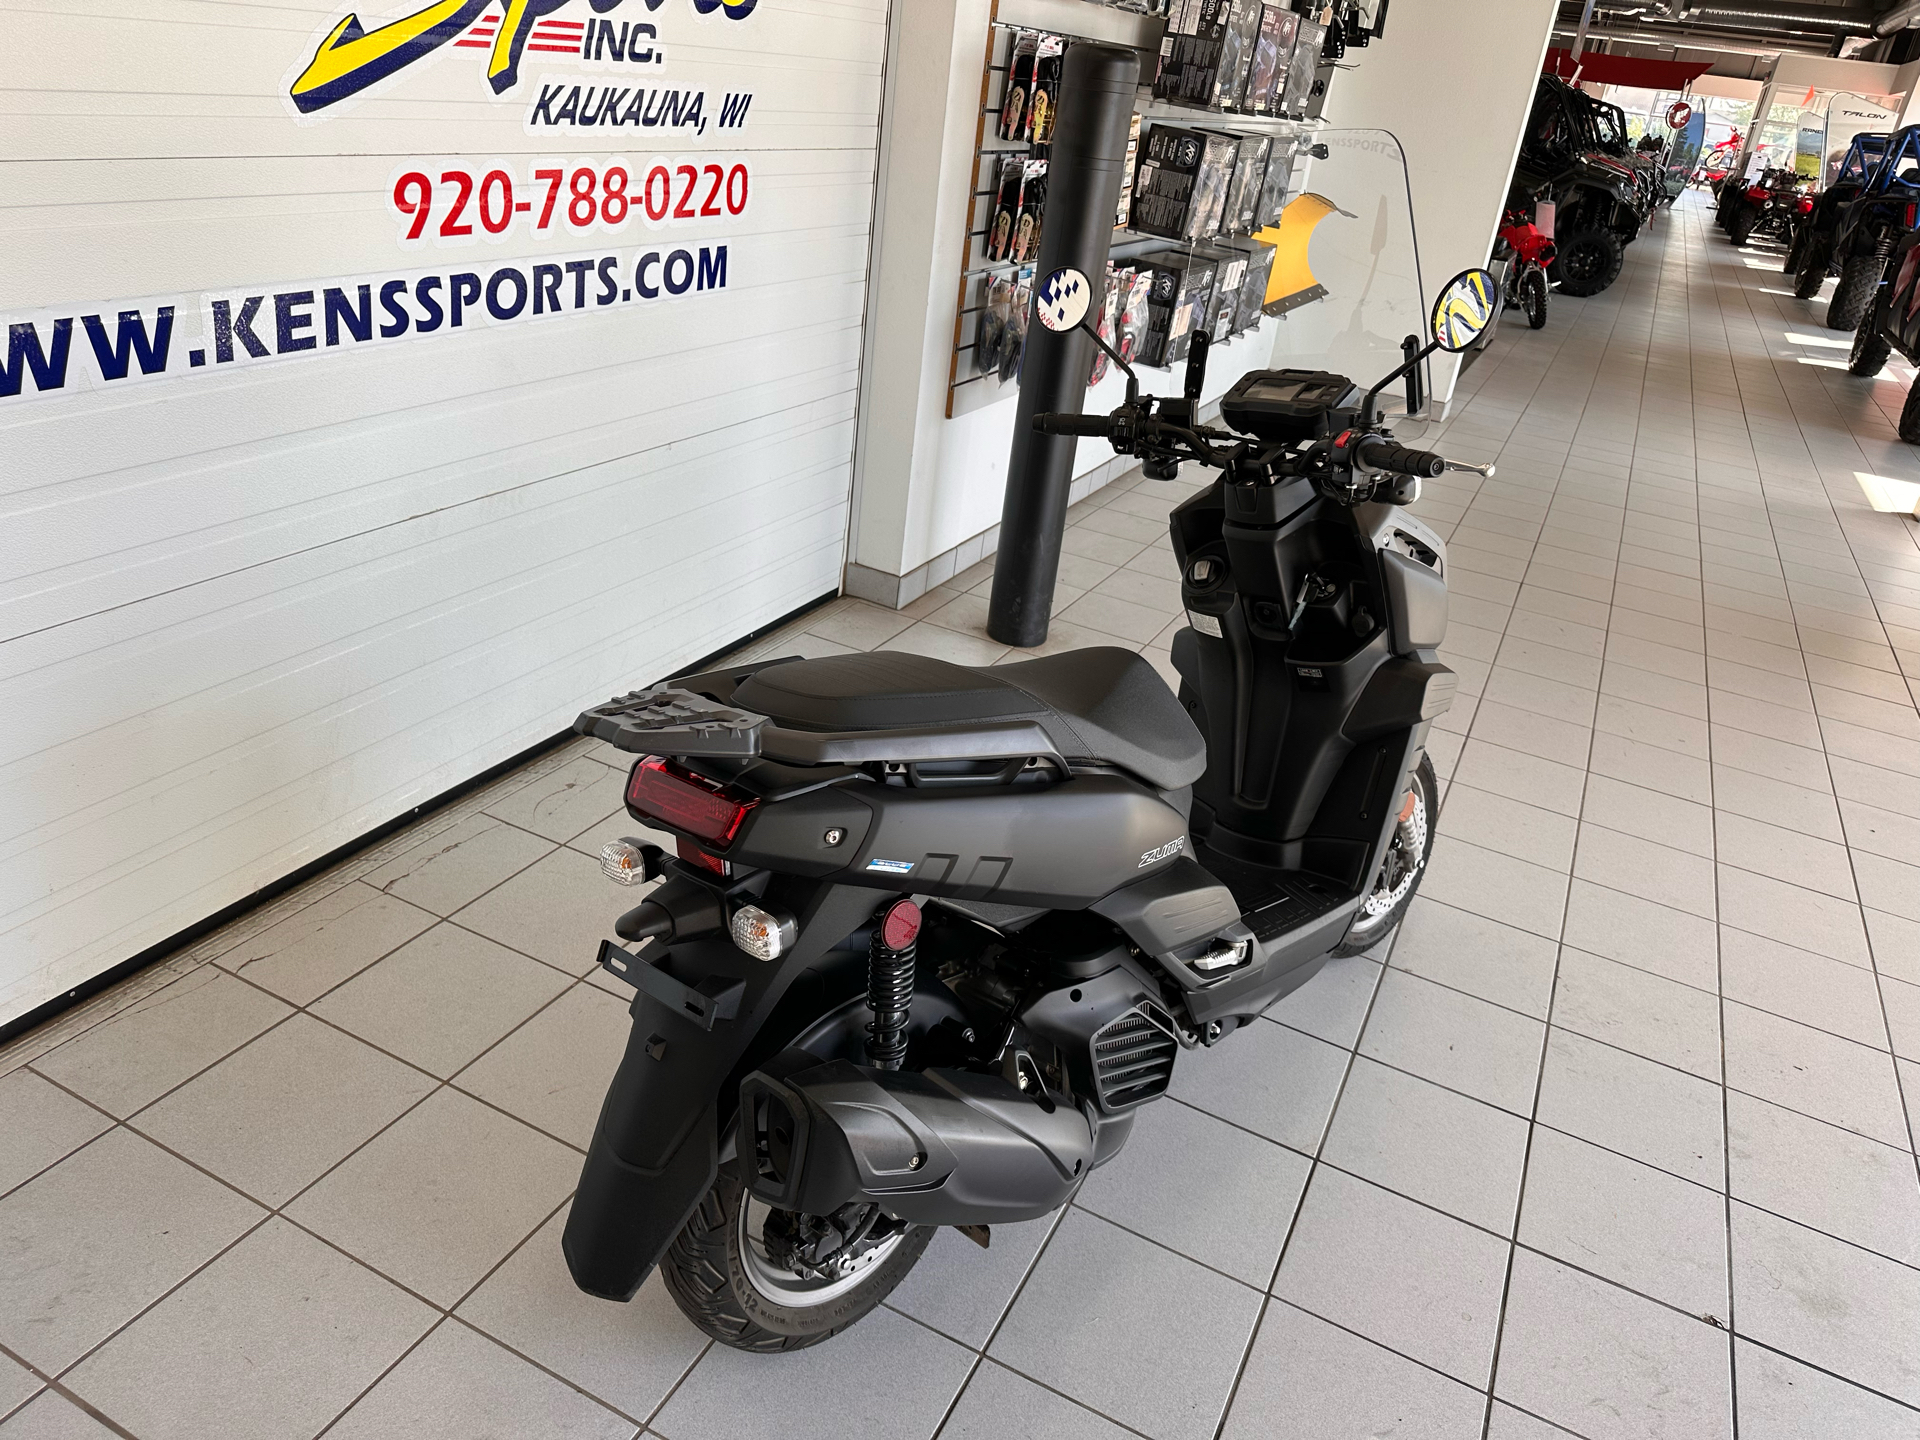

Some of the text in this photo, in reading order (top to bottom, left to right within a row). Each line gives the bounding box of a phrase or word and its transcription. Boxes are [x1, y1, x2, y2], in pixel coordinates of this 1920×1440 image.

[584, 18, 661, 64] INC.
[531, 84, 752, 135] KAUKAUNA, WI
[1842, 110, 1887, 119] TALON
[393, 164, 748, 240] 920-788-0220
[1138, 835, 1184, 868] ZUMA
